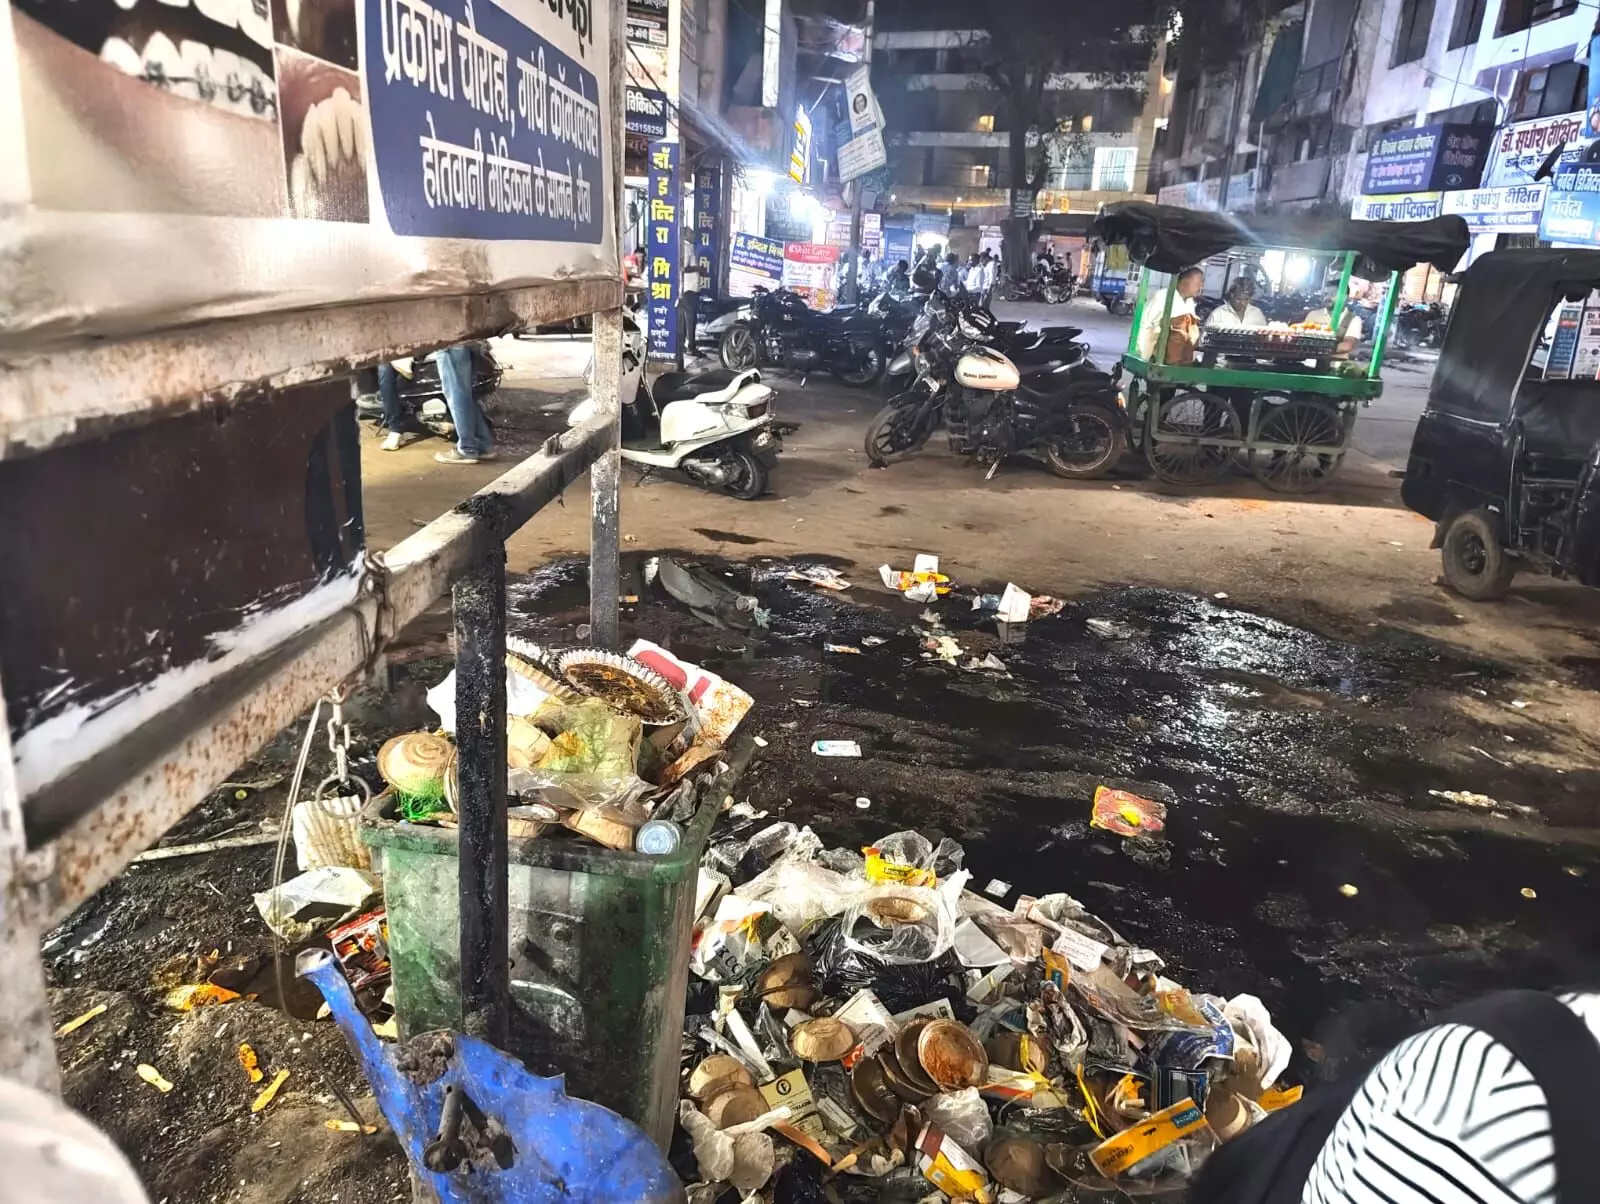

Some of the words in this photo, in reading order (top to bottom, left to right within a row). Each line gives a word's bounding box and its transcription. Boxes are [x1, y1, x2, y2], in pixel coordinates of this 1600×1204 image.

[381, 0, 454, 100] प्रकाश
[516, 46, 548, 136] गांधी
[419, 110, 485, 211] होतवानी
[487, 132, 533, 216] मेडिकल
[533, 147, 546, 216] के
[577, 162, 592, 223] रीवा
[1501, 127, 1513, 153] डॉ.
[1514, 124, 1547, 154] सुधांशु
[1547, 118, 1582, 147] दीक्षित
[1505, 187, 1542, 204] दीक्षित
